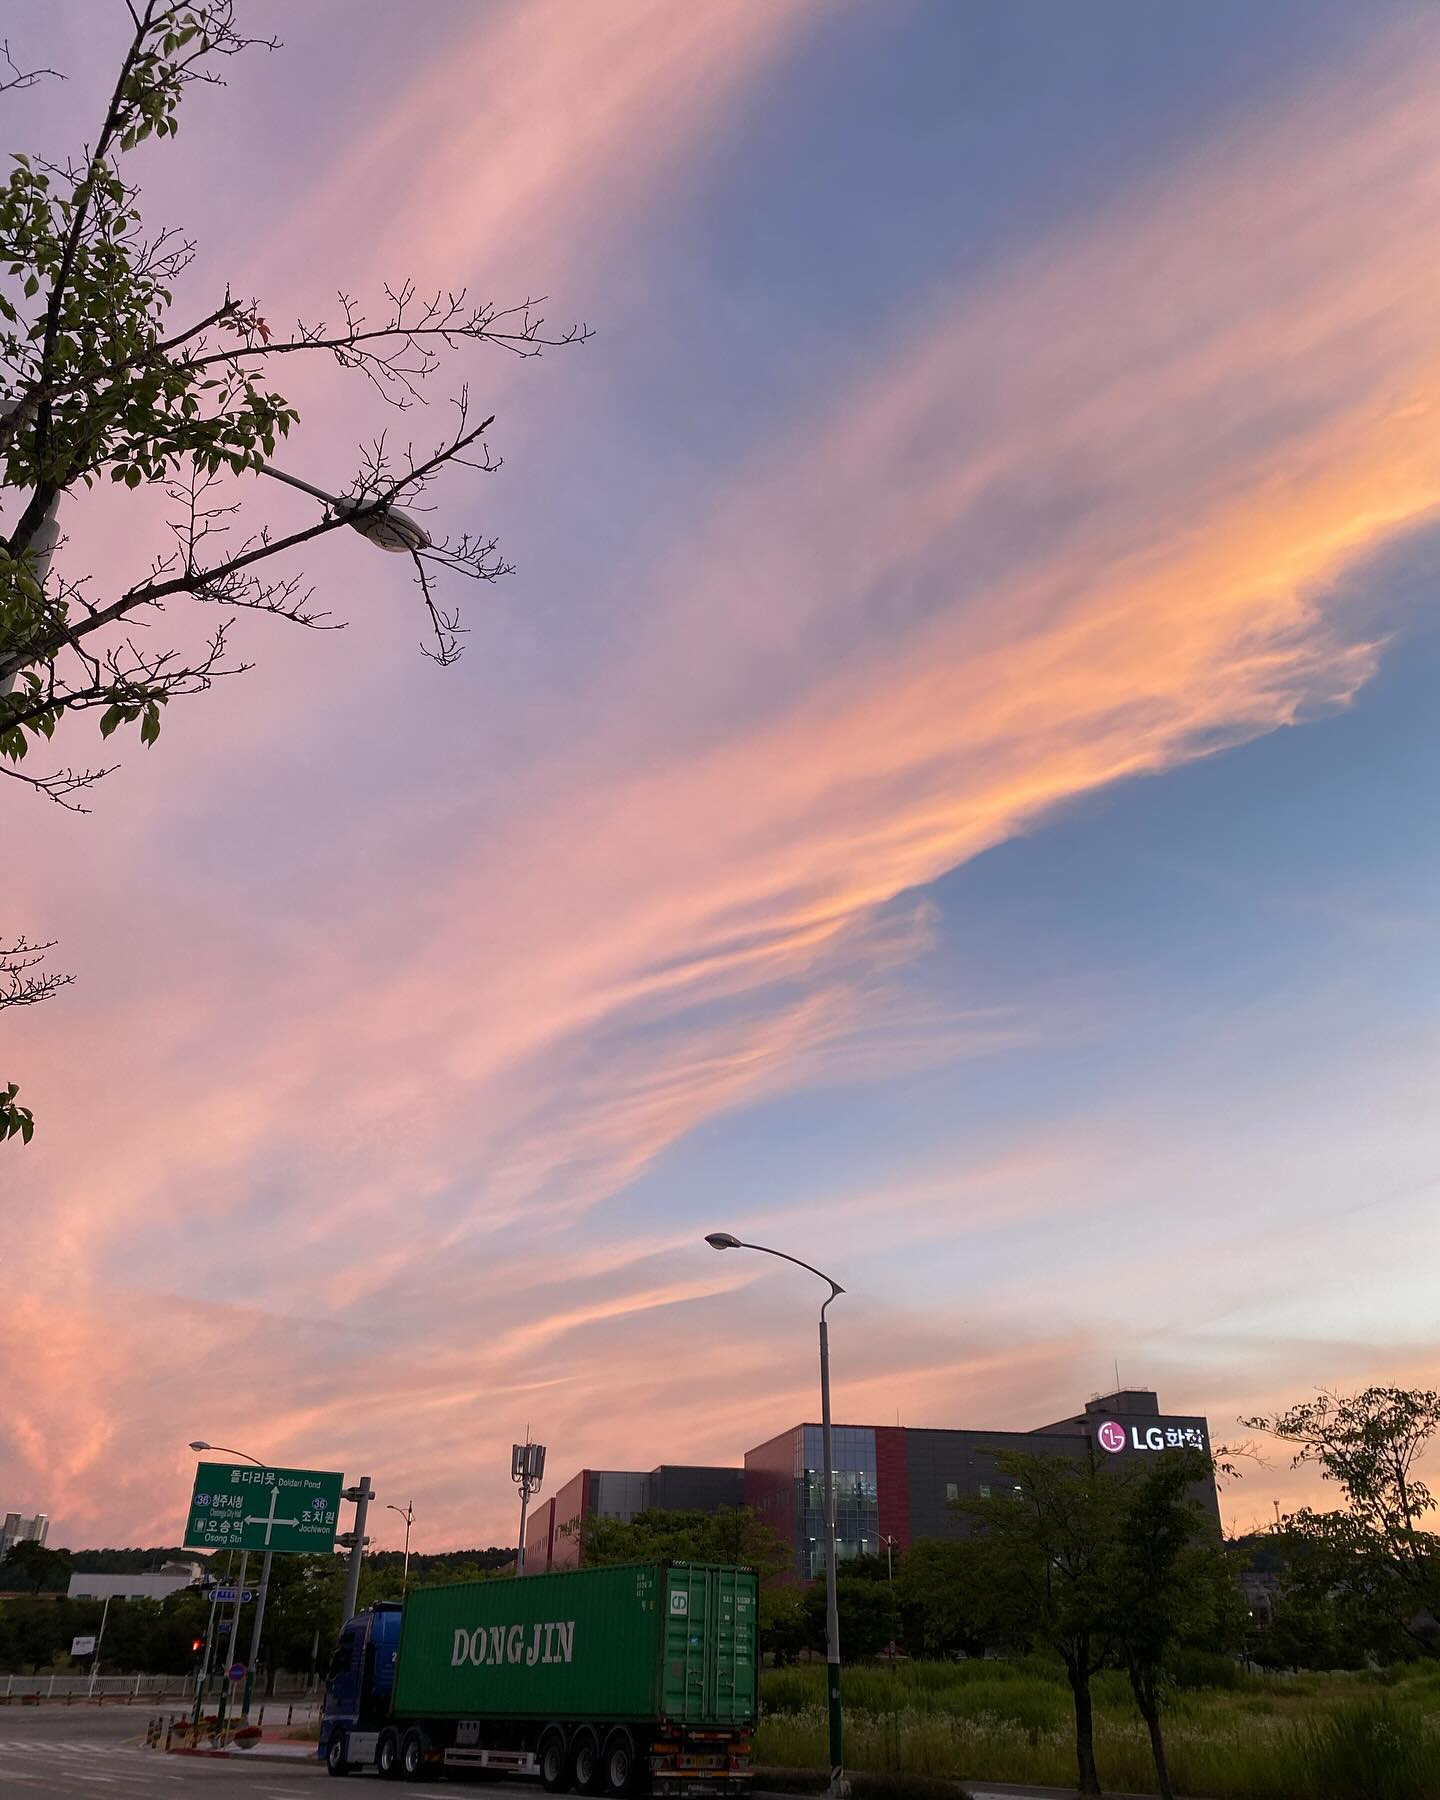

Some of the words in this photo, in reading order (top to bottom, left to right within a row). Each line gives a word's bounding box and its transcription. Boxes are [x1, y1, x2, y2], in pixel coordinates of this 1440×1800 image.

[1131, 1426, 1204, 1451] LG화학
[230, 1470, 275, 1485] 돌다리못
[278, 1477, 303, 1488] Doldari
[304, 1480, 321, 1489] Pond
[197, 1496, 208, 1505] 36
[212, 1494, 243, 1509] 청주시청
[313, 1499, 325, 1509] 36
[301, 1510, 335, 1525] 조치원
[206, 1520, 244, 1534] 오송역
[298, 1524, 331, 1534] Jochiwon
[204, 1533, 228, 1544] Osong
[229, 1534, 242, 1543] Stn
[451, 1621, 575, 1666] DONGJIN
